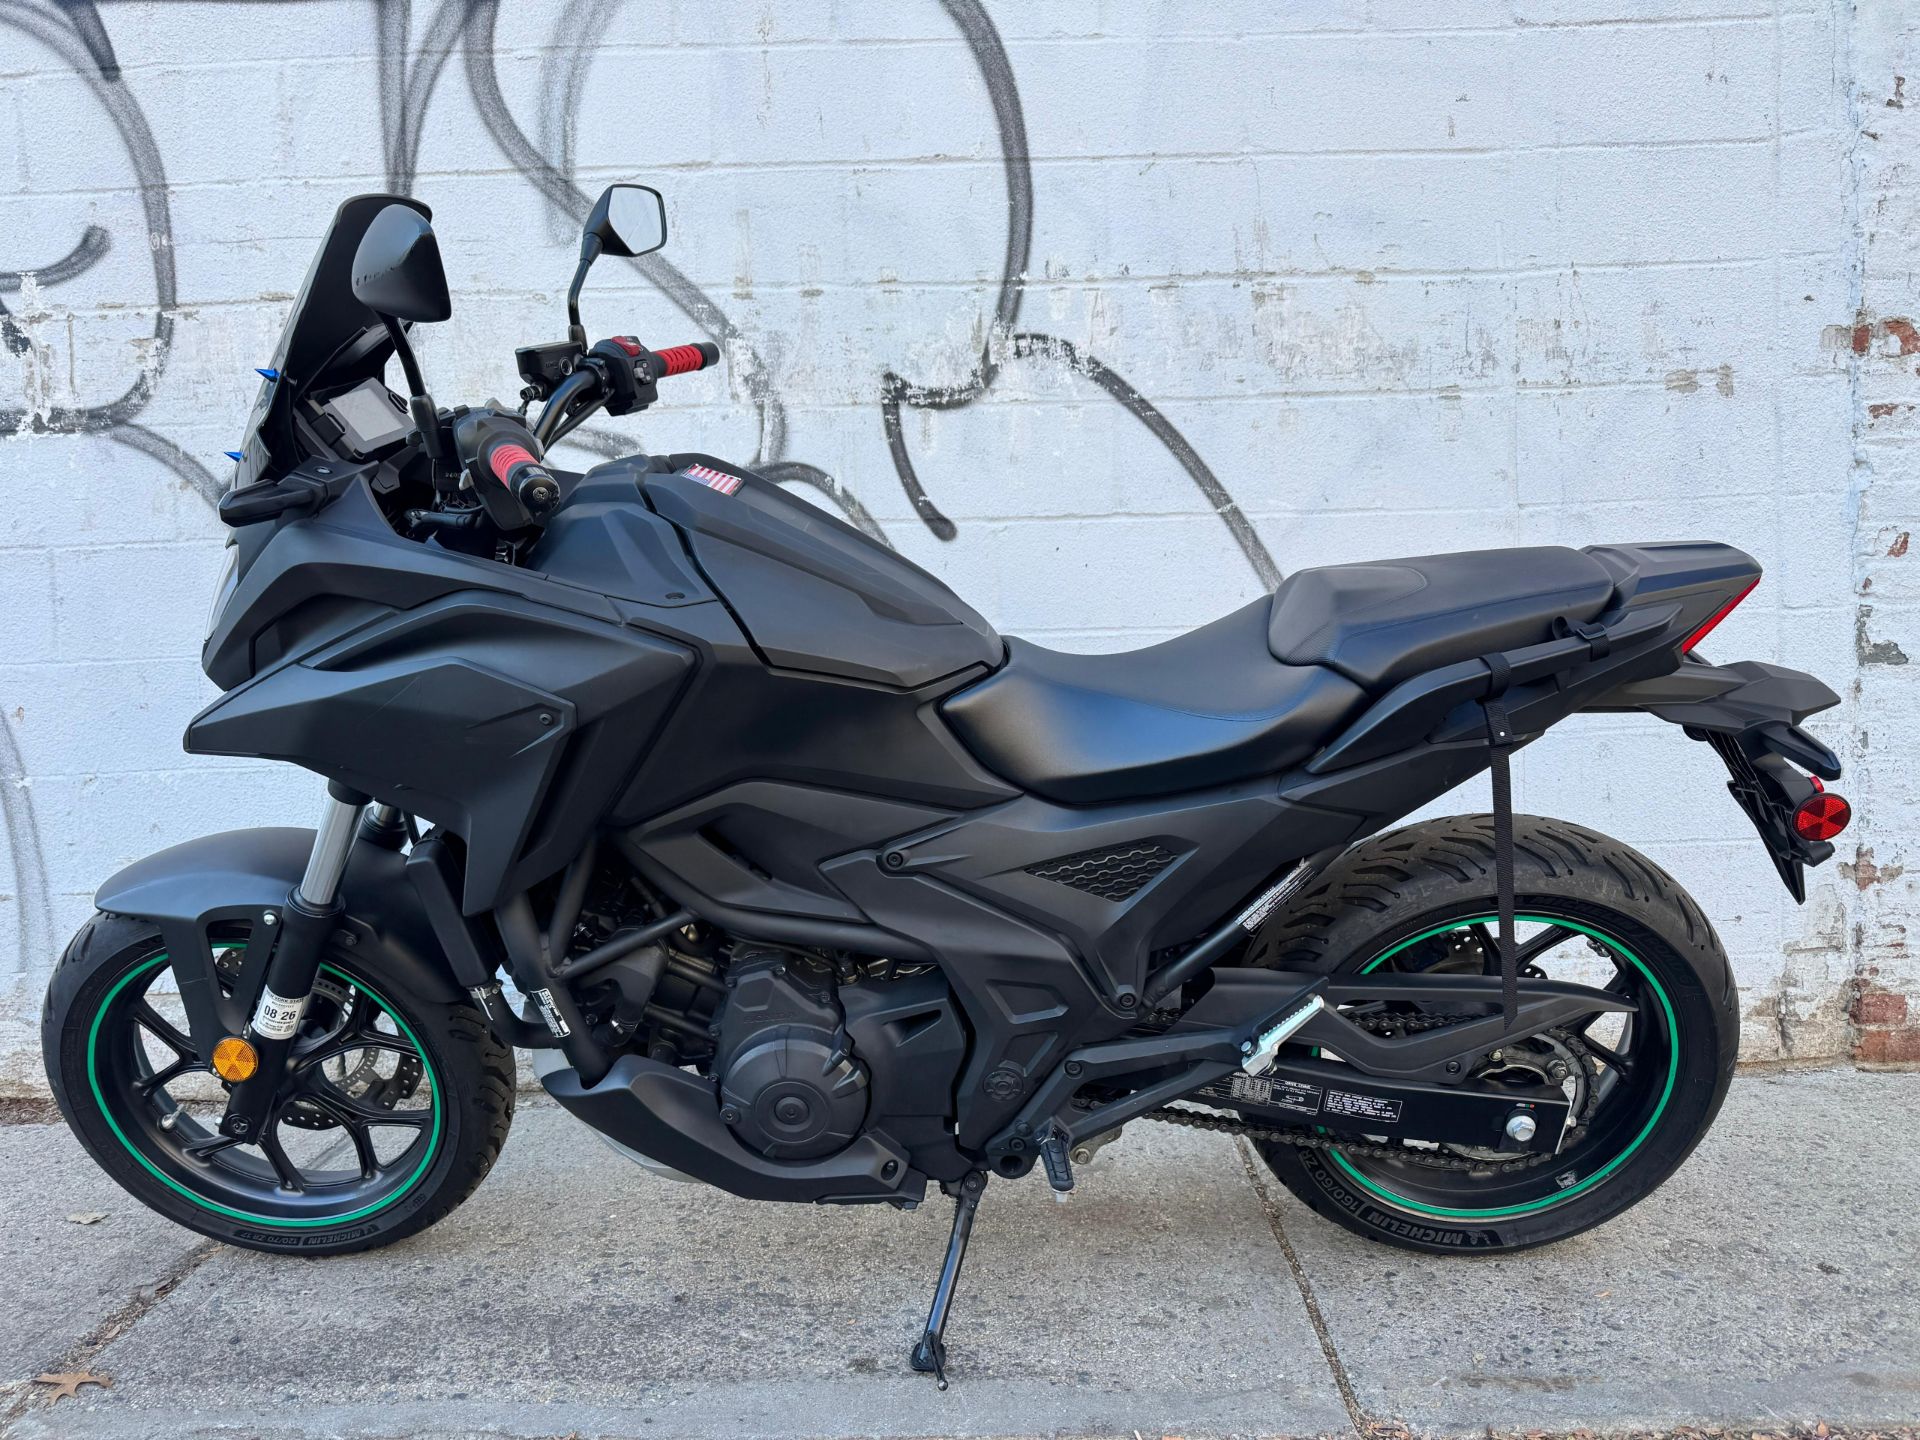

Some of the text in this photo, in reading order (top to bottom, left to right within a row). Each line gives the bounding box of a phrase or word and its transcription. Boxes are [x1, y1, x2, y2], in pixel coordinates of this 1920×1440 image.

[264, 1004, 278, 1019] 08
[280, 1010, 297, 1021] 26
[1315, 1169, 1360, 1212] 160/60
[240, 1229, 361, 1246] MICHELIN 120/70 ZR 17
[1367, 1211, 1463, 1246] MICHELIN
